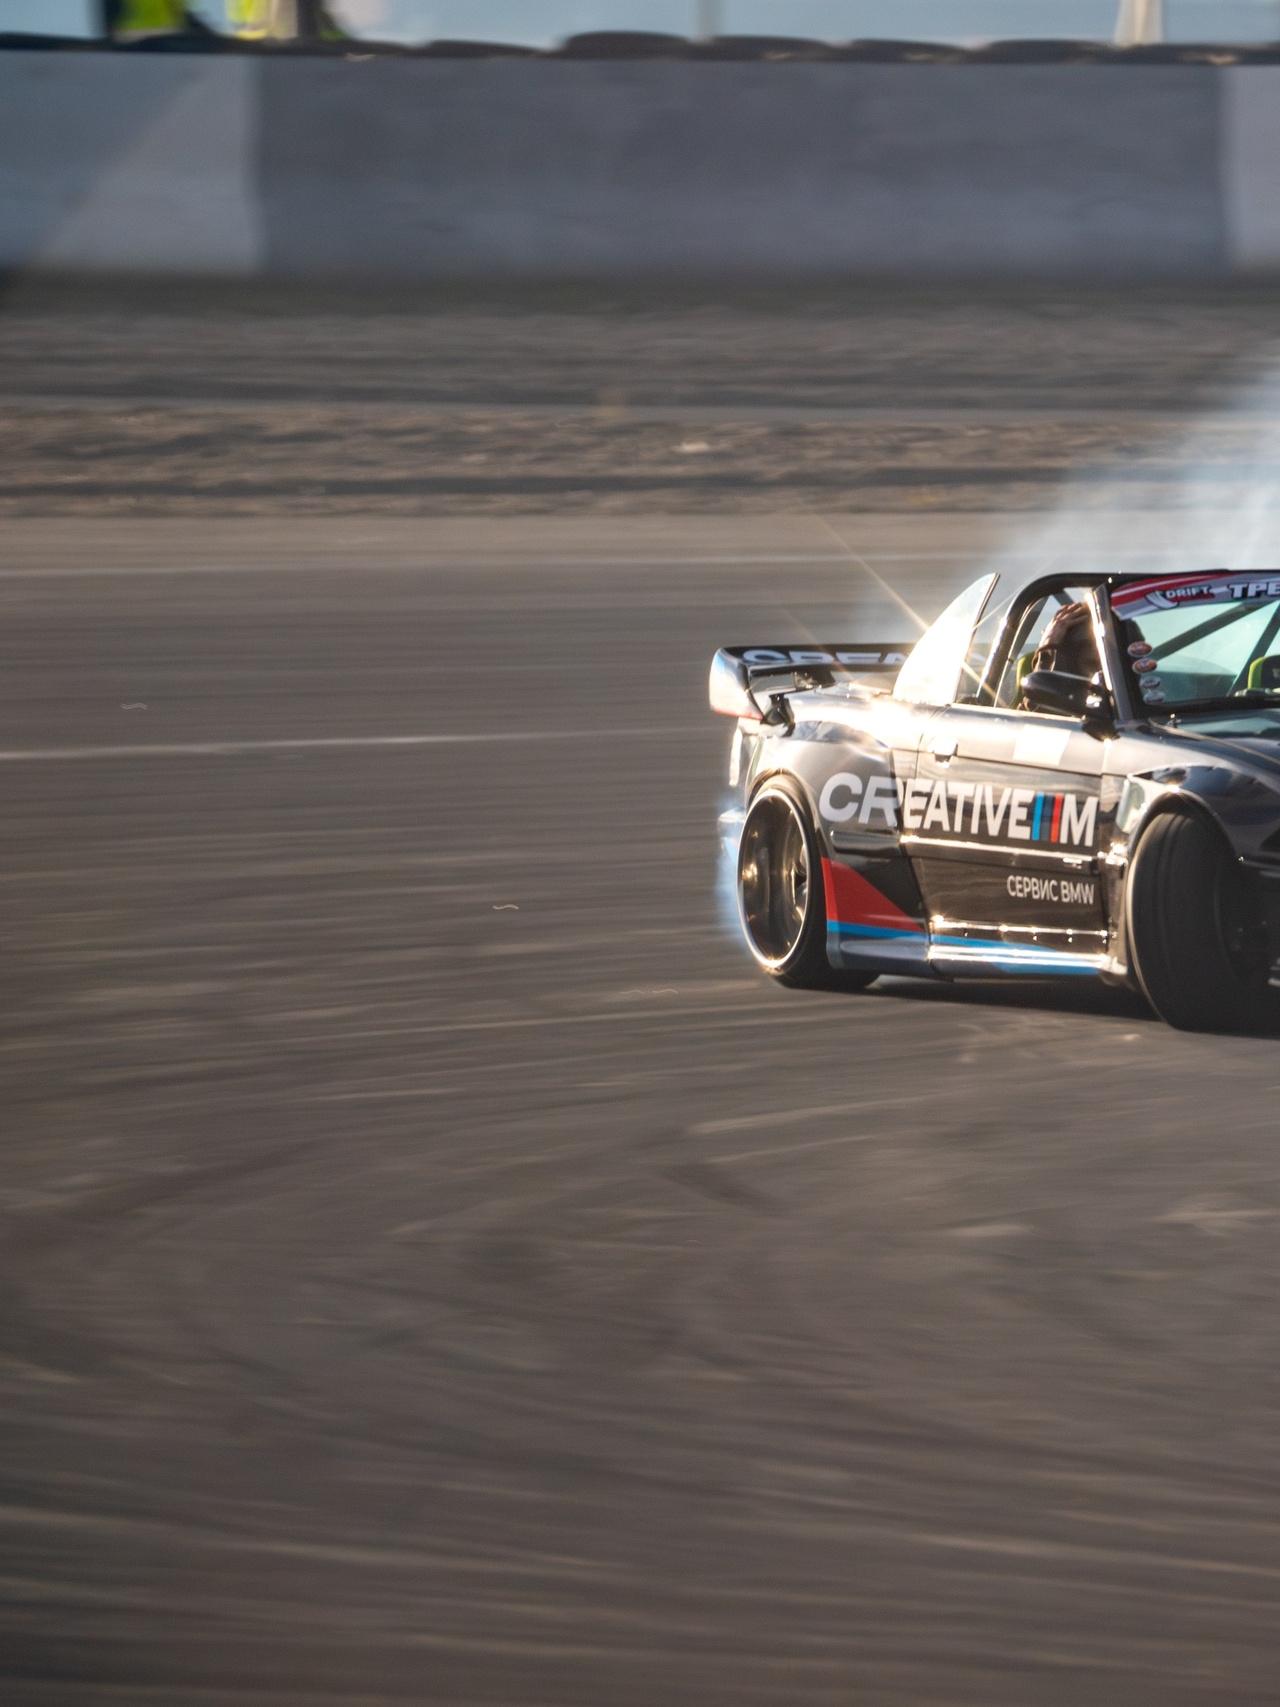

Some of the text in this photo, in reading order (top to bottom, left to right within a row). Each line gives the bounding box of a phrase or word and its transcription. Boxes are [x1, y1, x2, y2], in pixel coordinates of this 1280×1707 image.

[1166, 586, 1210, 599] DRIFT
[1007, 875, 1095, 905] СЕРВИС BMW
